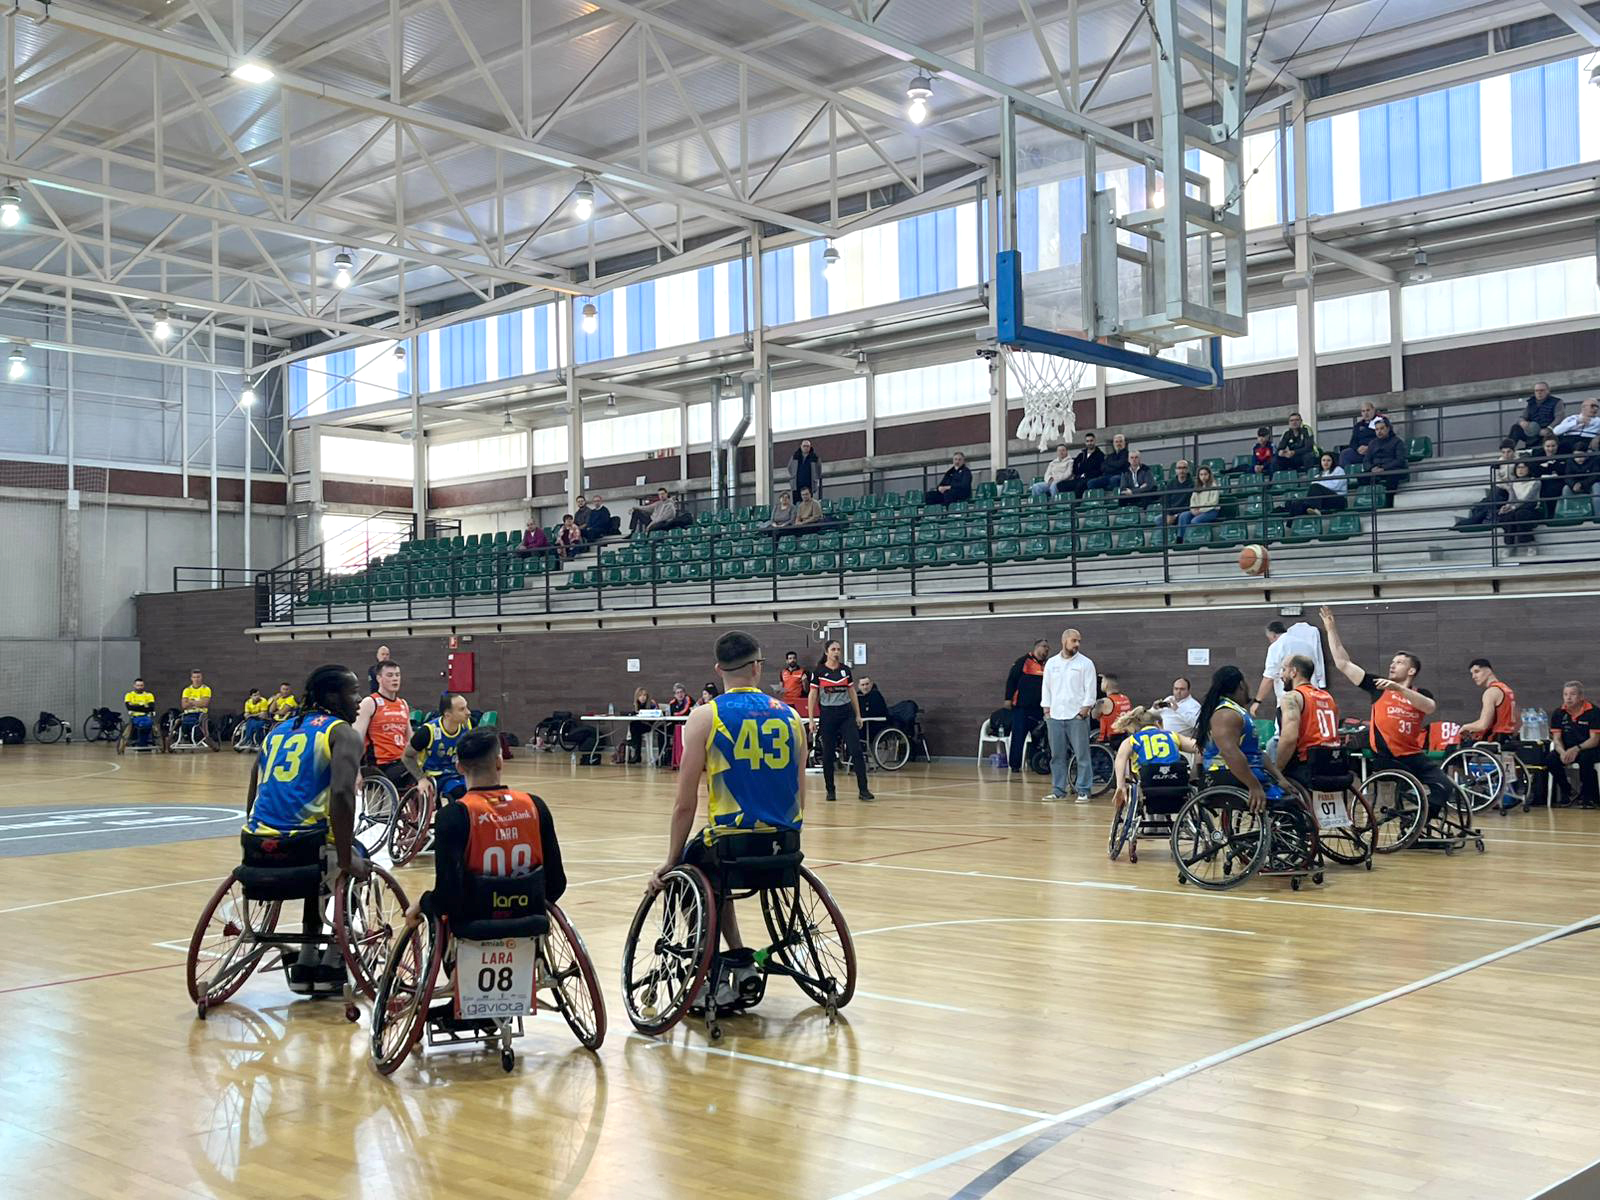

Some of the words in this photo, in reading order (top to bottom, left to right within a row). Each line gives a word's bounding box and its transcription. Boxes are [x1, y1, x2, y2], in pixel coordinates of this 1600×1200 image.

[1316, 709, 1337, 738] 07
[1398, 720, 1412, 735] 33
[733, 718, 790, 770] 43
[1140, 733, 1170, 760] 16
[263, 733, 308, 783] 13
[1321, 801, 1337, 816] 07
[495, 826, 519, 841] LARA
[481, 951, 513, 965] LARA
[478, 966, 514, 993] 08
